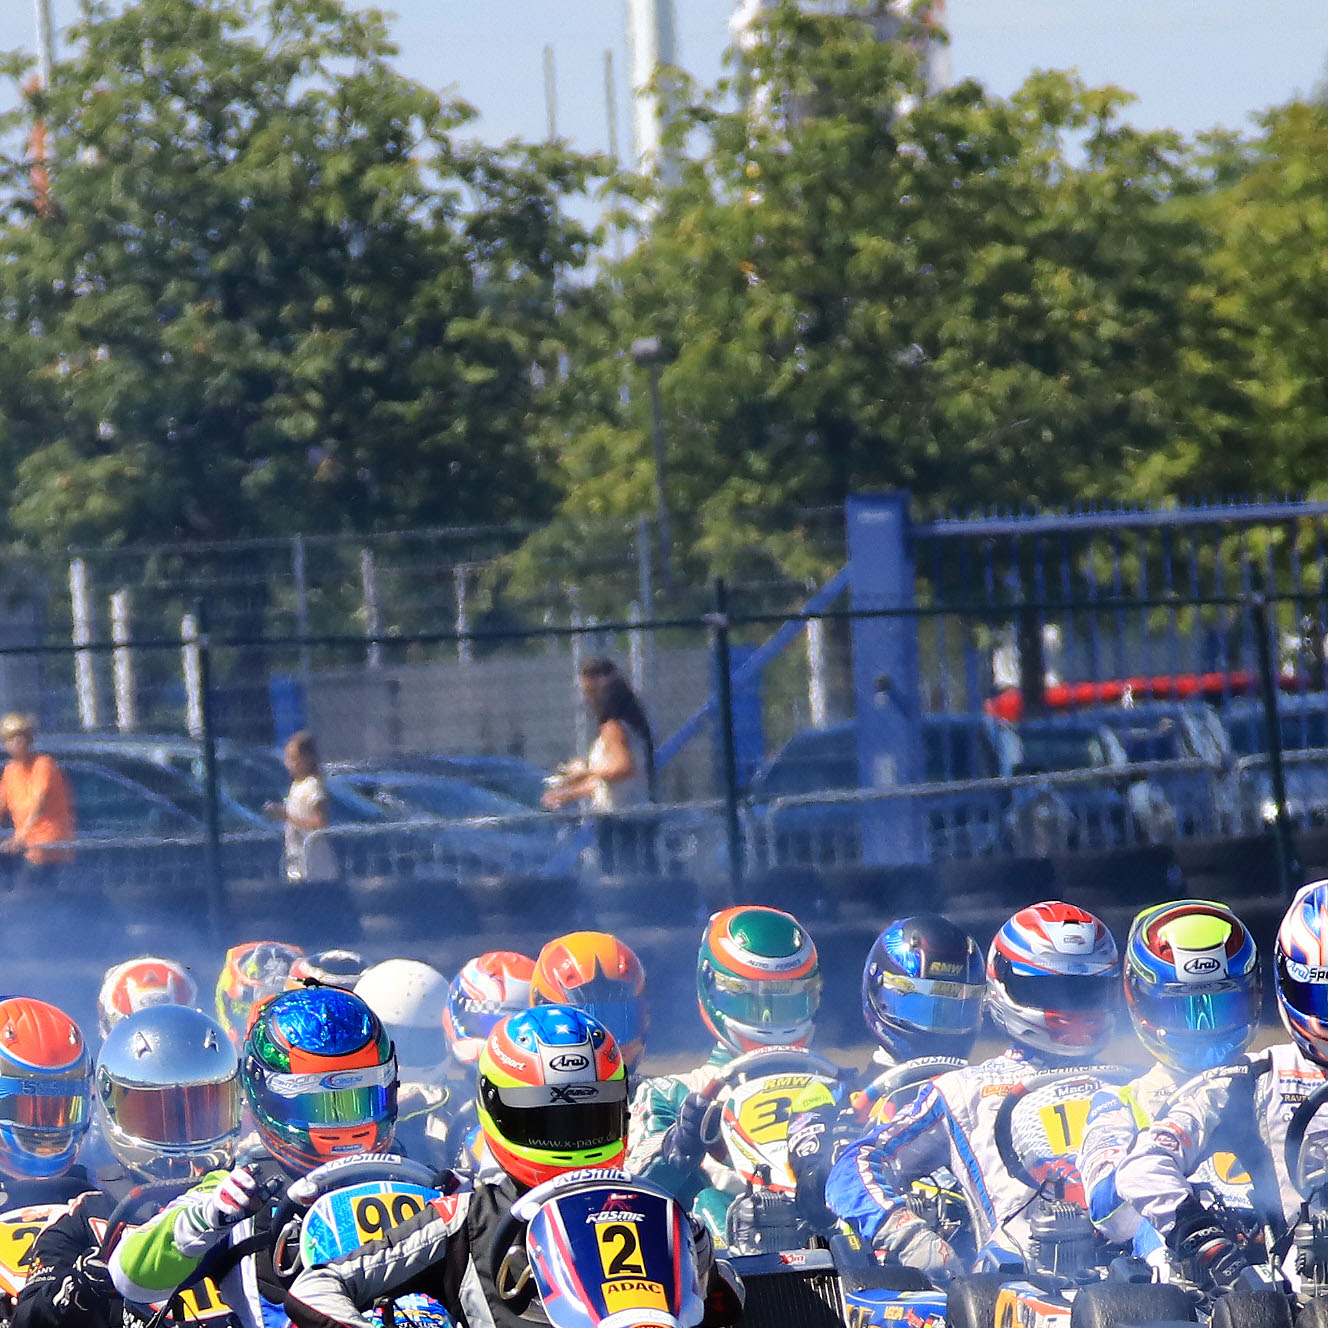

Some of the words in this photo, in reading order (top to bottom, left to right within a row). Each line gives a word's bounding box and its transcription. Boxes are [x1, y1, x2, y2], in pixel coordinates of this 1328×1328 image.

[1189, 959, 1217, 971] Arai
[553, 1056, 584, 1067] Arai
[750, 1097, 792, 1134] 3
[556, 1169, 629, 1186] KOSMIC
[586, 1211, 646, 1223] KOSMIC
[602, 1224, 643, 1275] 2
[607, 1282, 662, 1295] ADAC
